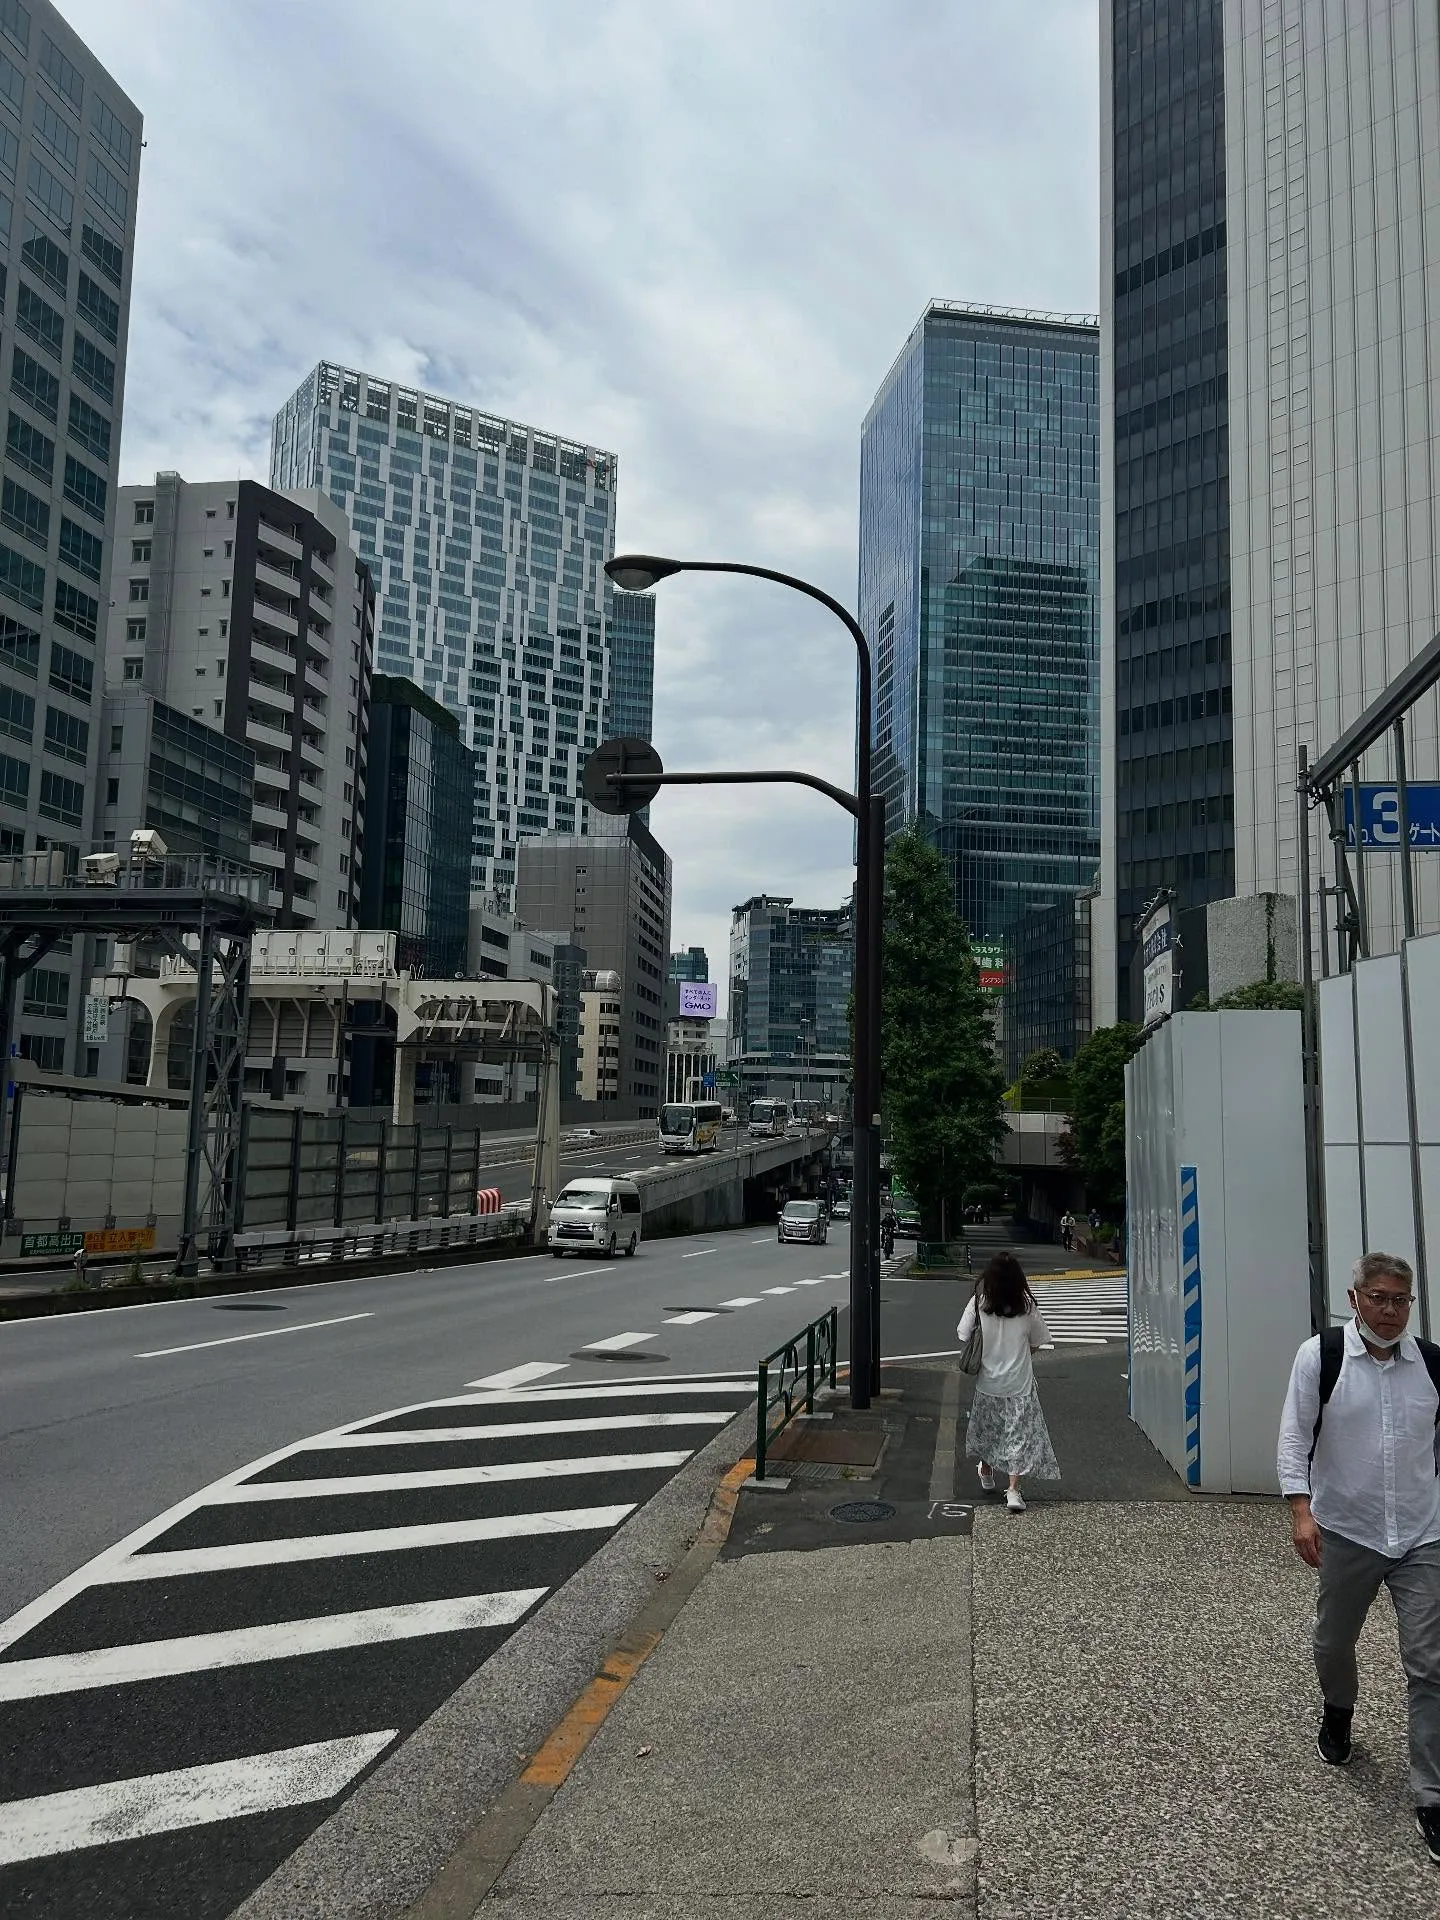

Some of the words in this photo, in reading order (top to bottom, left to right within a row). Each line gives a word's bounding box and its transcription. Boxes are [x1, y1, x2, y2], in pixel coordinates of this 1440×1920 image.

[684, 1002, 711, 1010] GMO
[24, 1234, 83, 1249] 首都高出口
